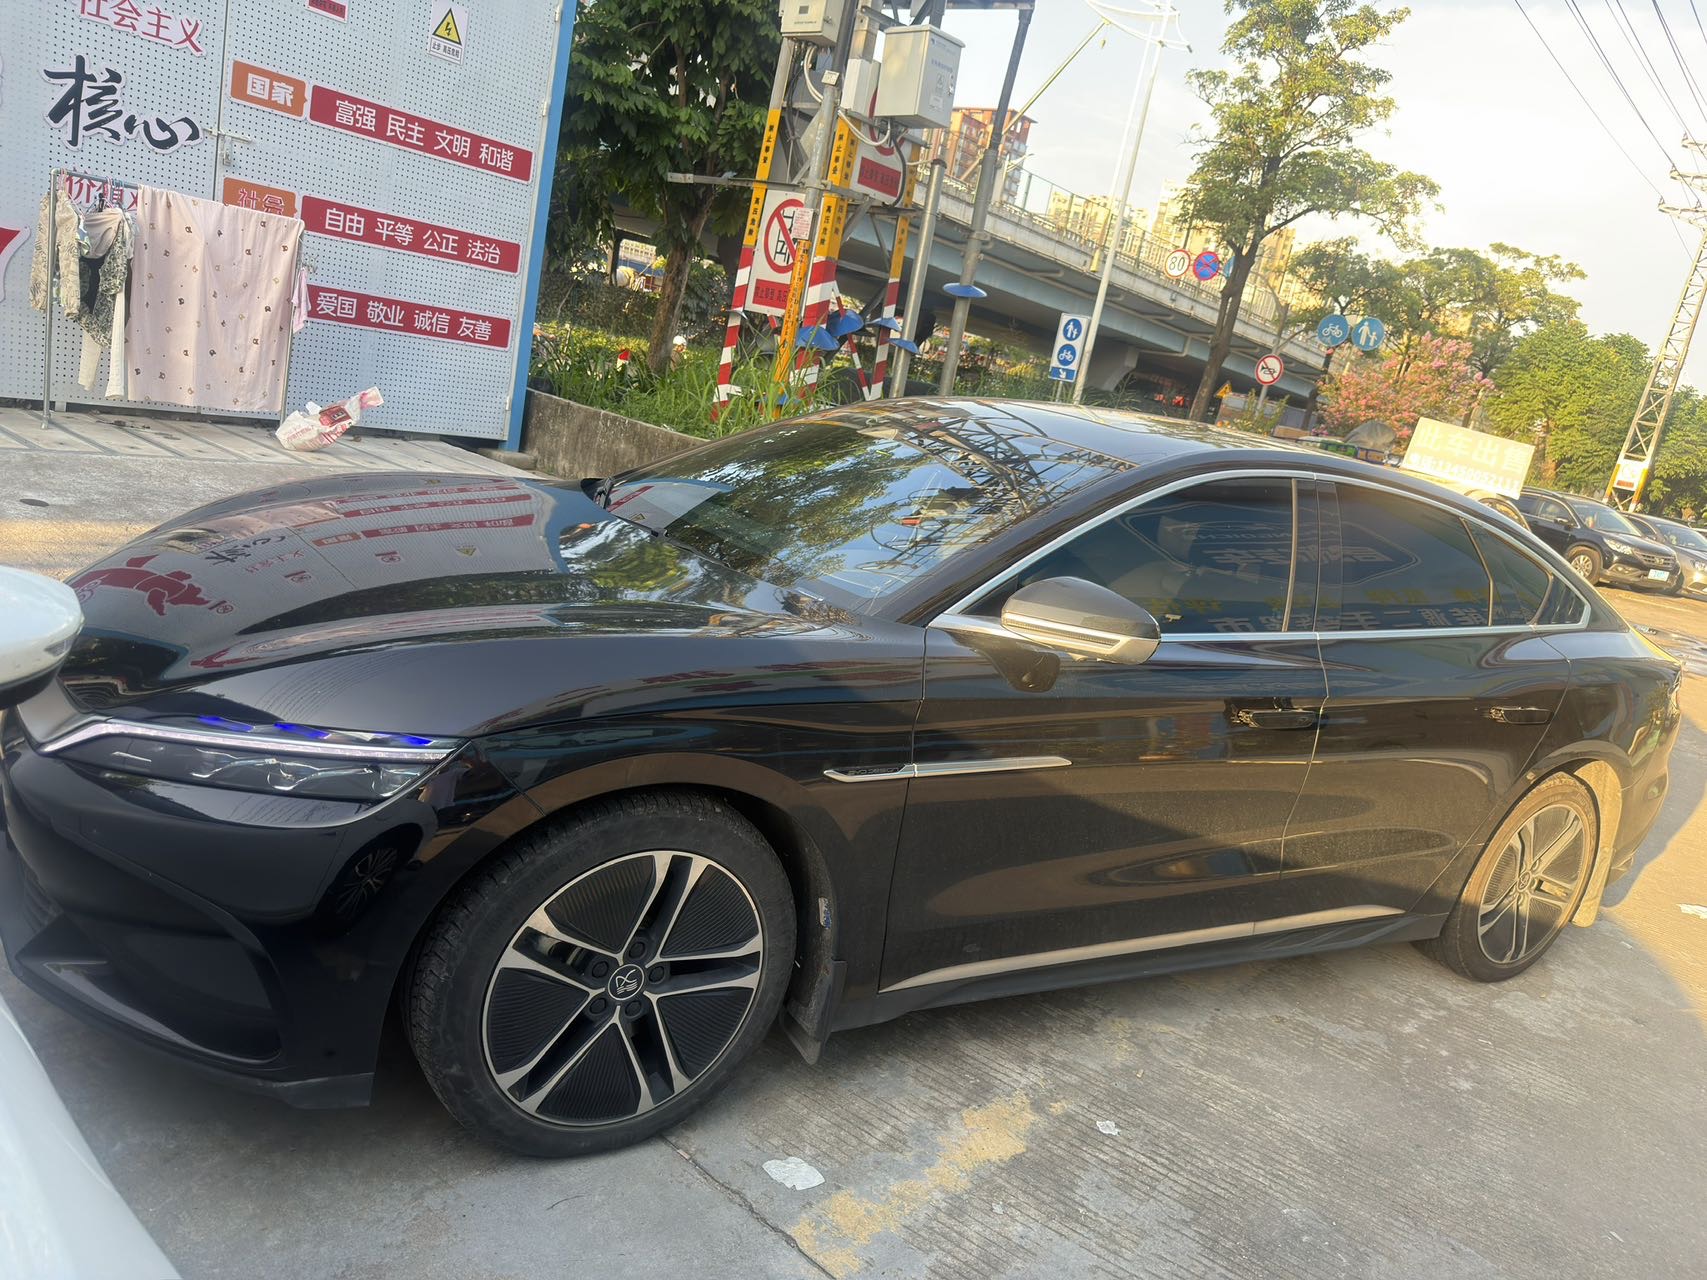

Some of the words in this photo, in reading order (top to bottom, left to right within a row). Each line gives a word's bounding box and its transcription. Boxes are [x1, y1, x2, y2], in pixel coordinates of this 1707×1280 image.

[43, 55, 200, 150] 核心
[246, 73, 295, 107] 国家
[335, 99, 377, 132] 富强
[386, 114, 425, 147] 民主
[434, 130, 471, 159] 文明
[479, 143, 514, 172] 和谐
[324, 207, 365, 237] 自由
[375, 217, 414, 247] 平等
[422, 229, 458, 256] 公正
[466, 239, 501, 265] 法治
[1169, 256, 1186, 272] 80
[316, 291, 357, 319] 爱国
[366, 300, 405, 327] 敬业
[413, 310, 450, 335] 诚信
[457, 315, 492, 342] 友善
